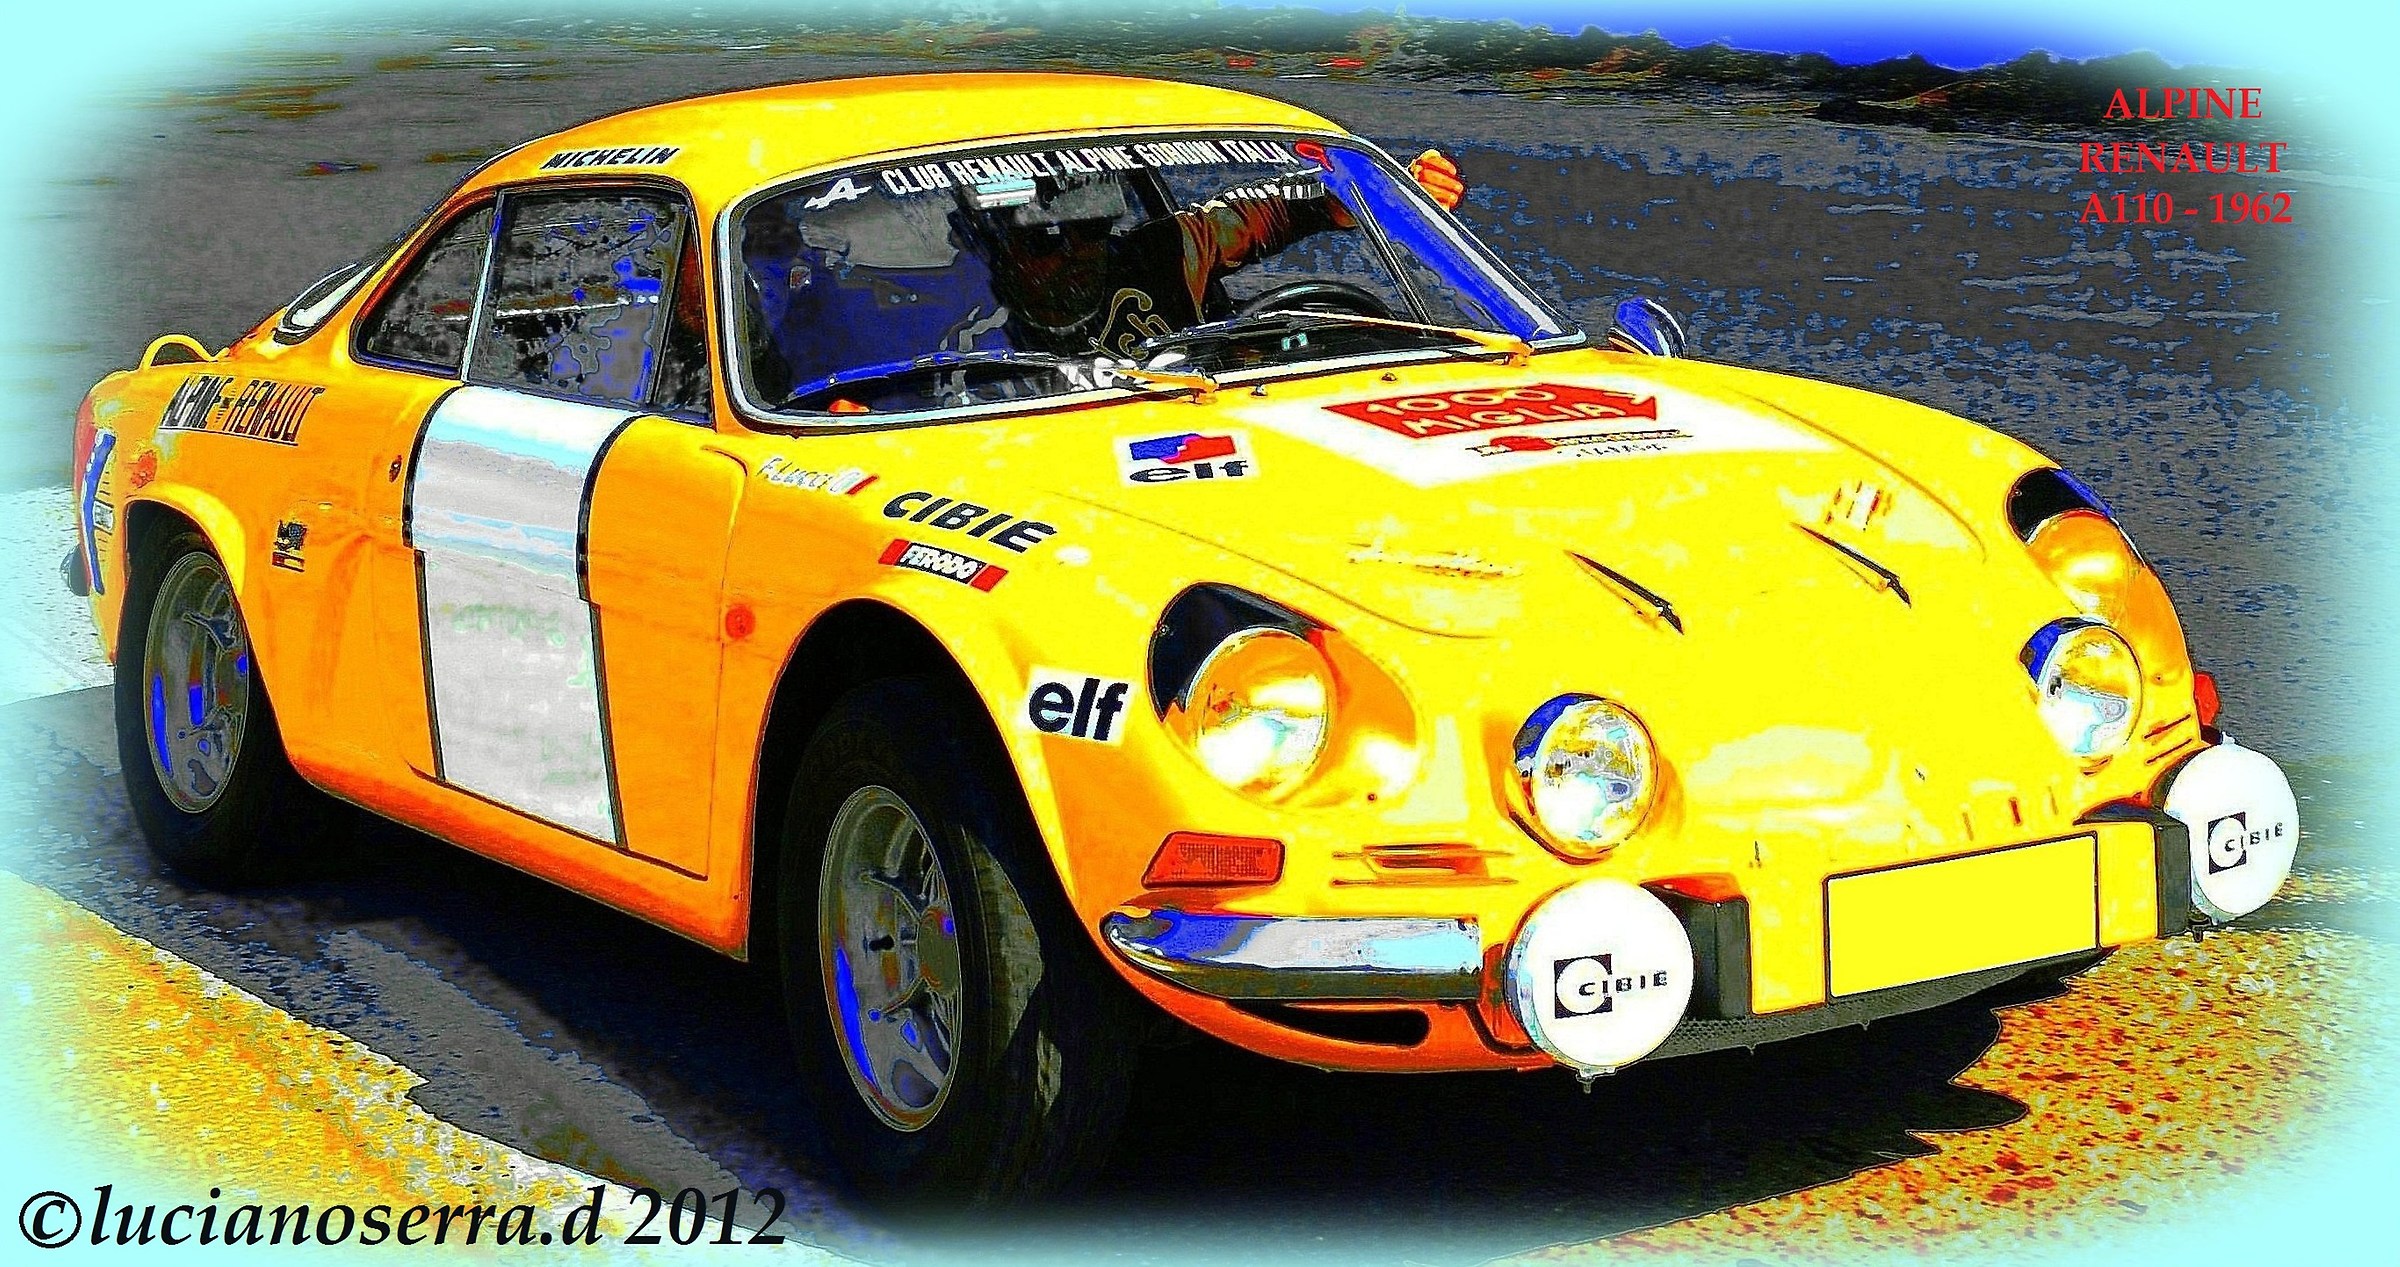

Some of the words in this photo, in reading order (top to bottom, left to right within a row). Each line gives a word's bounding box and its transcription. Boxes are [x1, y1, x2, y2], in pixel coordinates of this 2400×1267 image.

[540, 148, 680, 169] MICHELIN
[881, 163, 952, 195] CLUB
[949, 151, 1058, 186] RENAULT
[1055, 142, 1145, 175] ALPINE
[1133, 140, 1229, 167] GORDINI
[1220, 140, 1299, 165] ITALIA
[1366, 388, 1558, 416] 1000
[1401, 402, 1627, 435] MIGLIA
[1129, 460, 1249, 482] elf
[883, 491, 1058, 554] CIBIE
[899, 545, 979, 579] FERODO
[1028, 677, 1129, 741] elf
[2224, 822, 2283, 853] CIBIE
[1579, 970, 1668, 996] CIBIE
